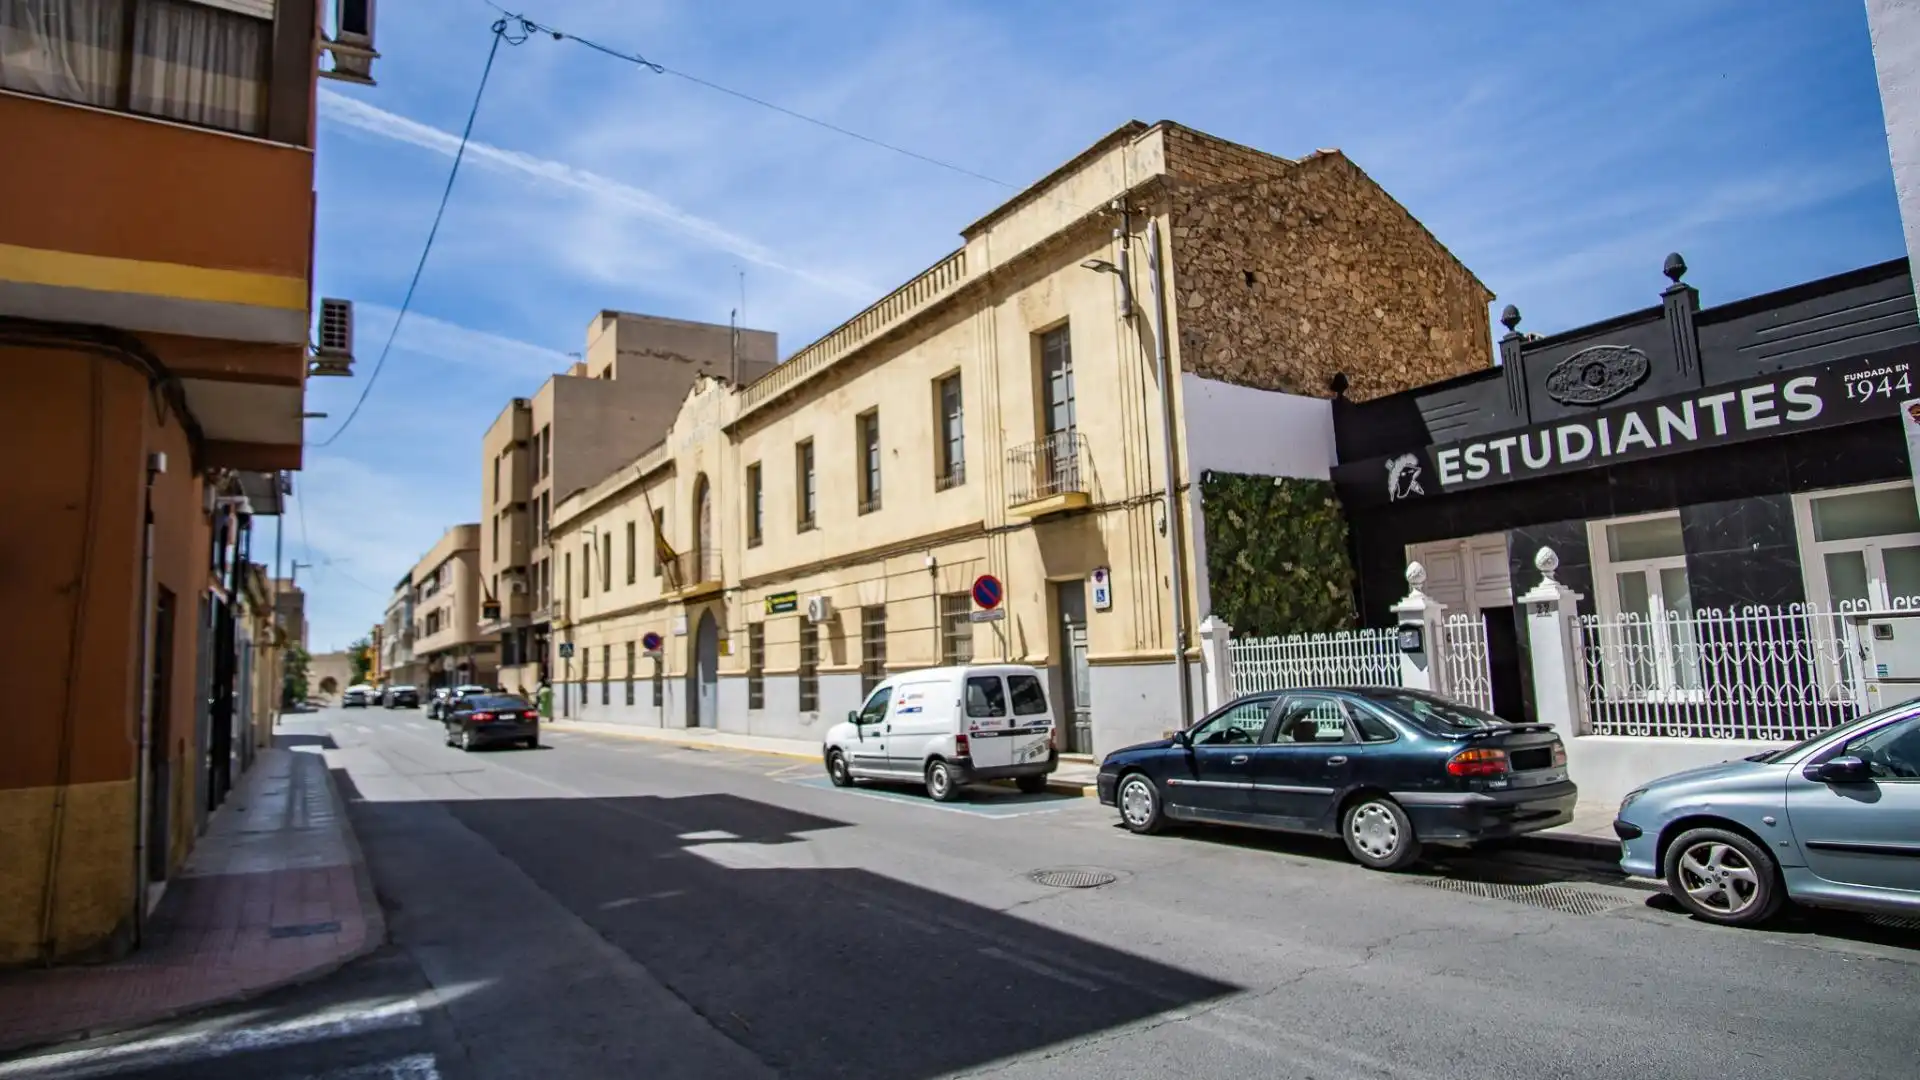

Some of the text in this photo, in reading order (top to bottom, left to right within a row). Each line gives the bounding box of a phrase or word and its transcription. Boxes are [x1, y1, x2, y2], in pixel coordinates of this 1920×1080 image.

[1844, 363, 1909, 381] FUNDADA EN
[1845, 372, 1912, 403] 1944
[1437, 376, 1823, 486] ESTUDIANTES
